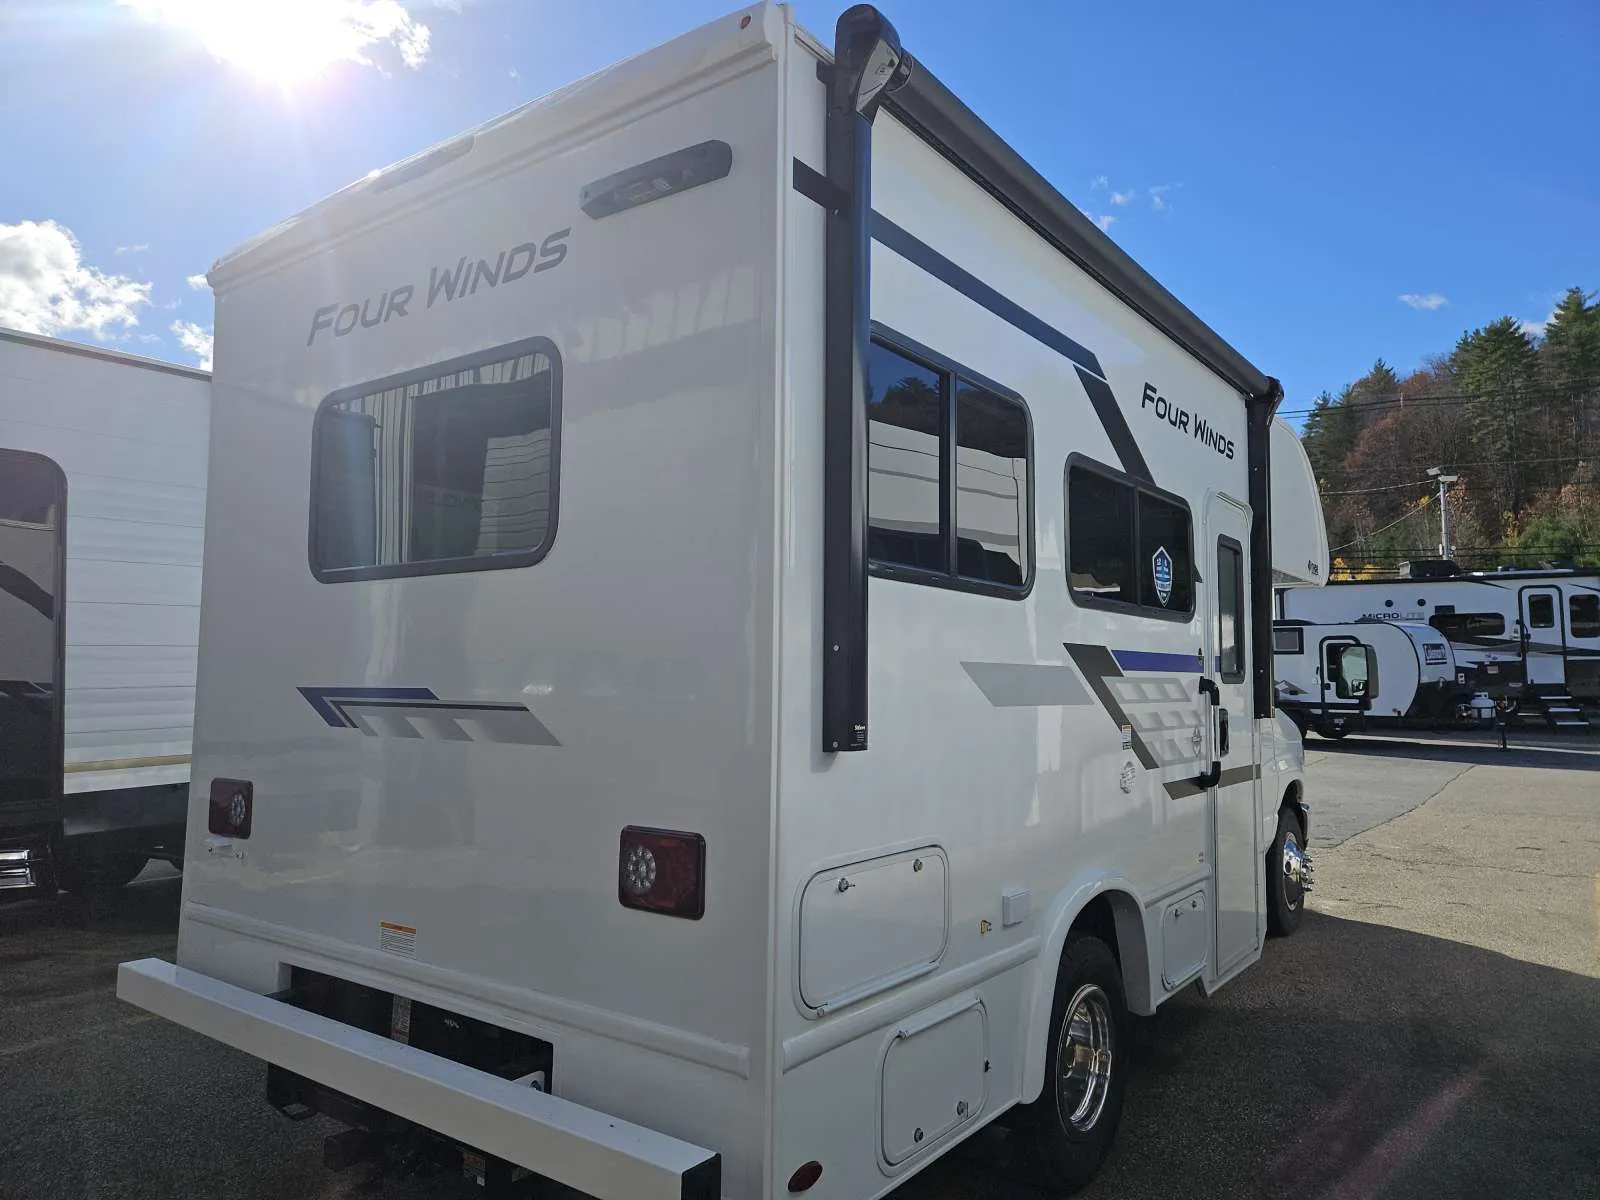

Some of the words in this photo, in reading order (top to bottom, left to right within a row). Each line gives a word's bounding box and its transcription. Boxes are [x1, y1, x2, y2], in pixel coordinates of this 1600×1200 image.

[307, 284, 414, 347] FOUR
[427, 227, 572, 309] WINDS
[1141, 382, 1190, 434] FOUR
[1194, 412, 1235, 460] WINDS
